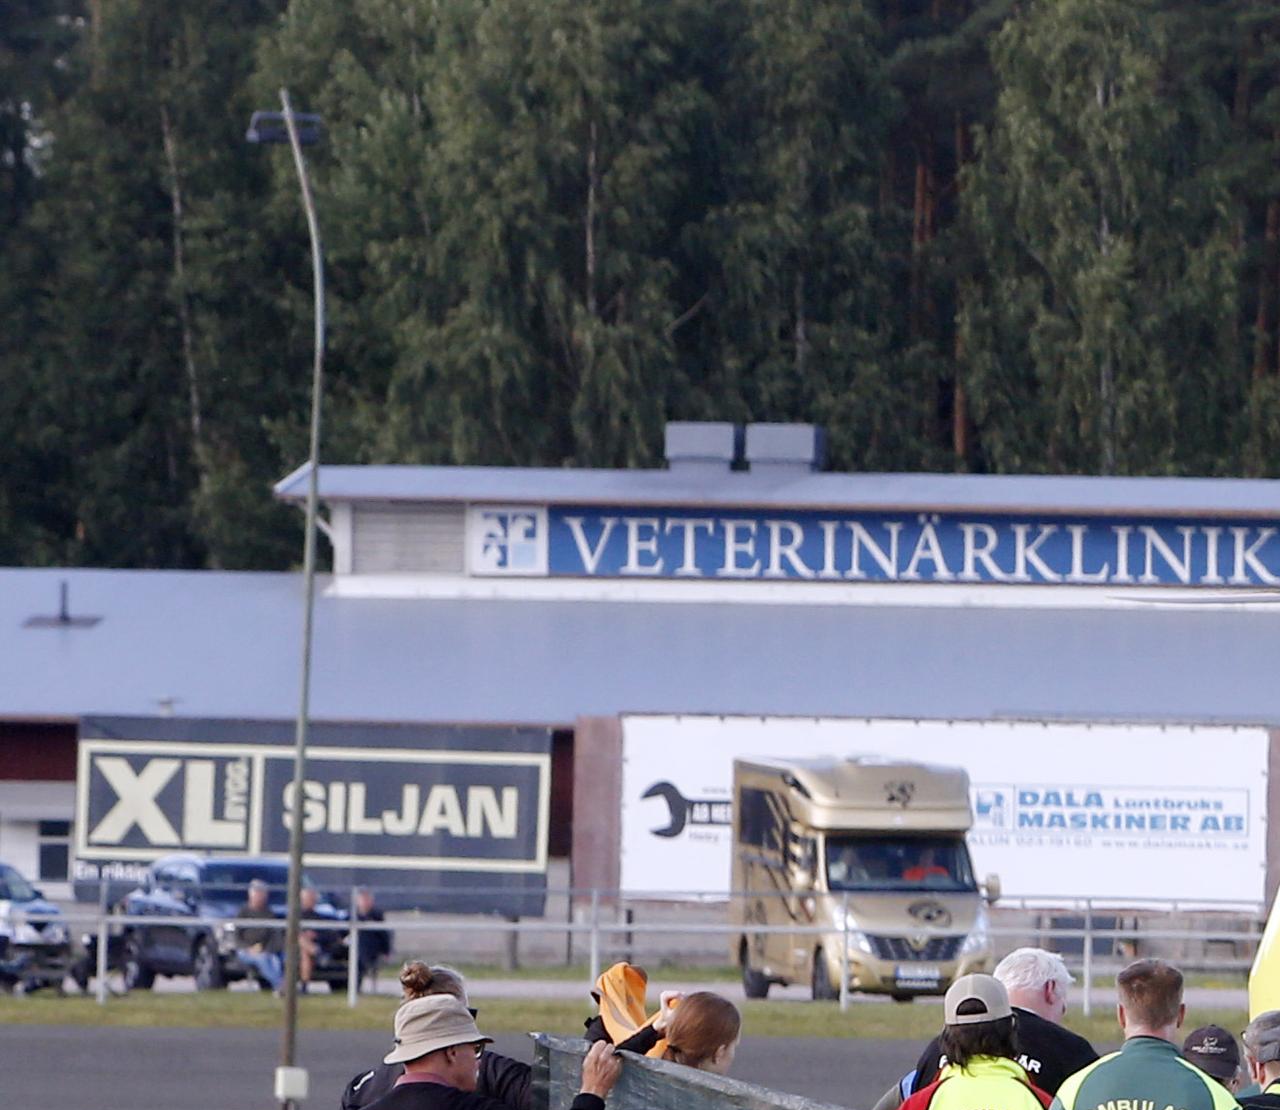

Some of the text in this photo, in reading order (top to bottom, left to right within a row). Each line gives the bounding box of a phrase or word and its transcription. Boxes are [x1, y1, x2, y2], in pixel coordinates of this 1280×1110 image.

[88, 756, 247, 847] XL
[282, 779, 518, 839] SILJAN
[1018, 790, 1223, 810] DALA Lantbruks
[1018, 812, 1192, 830] MASKINER
[1201, 814, 1244, 832] AB
